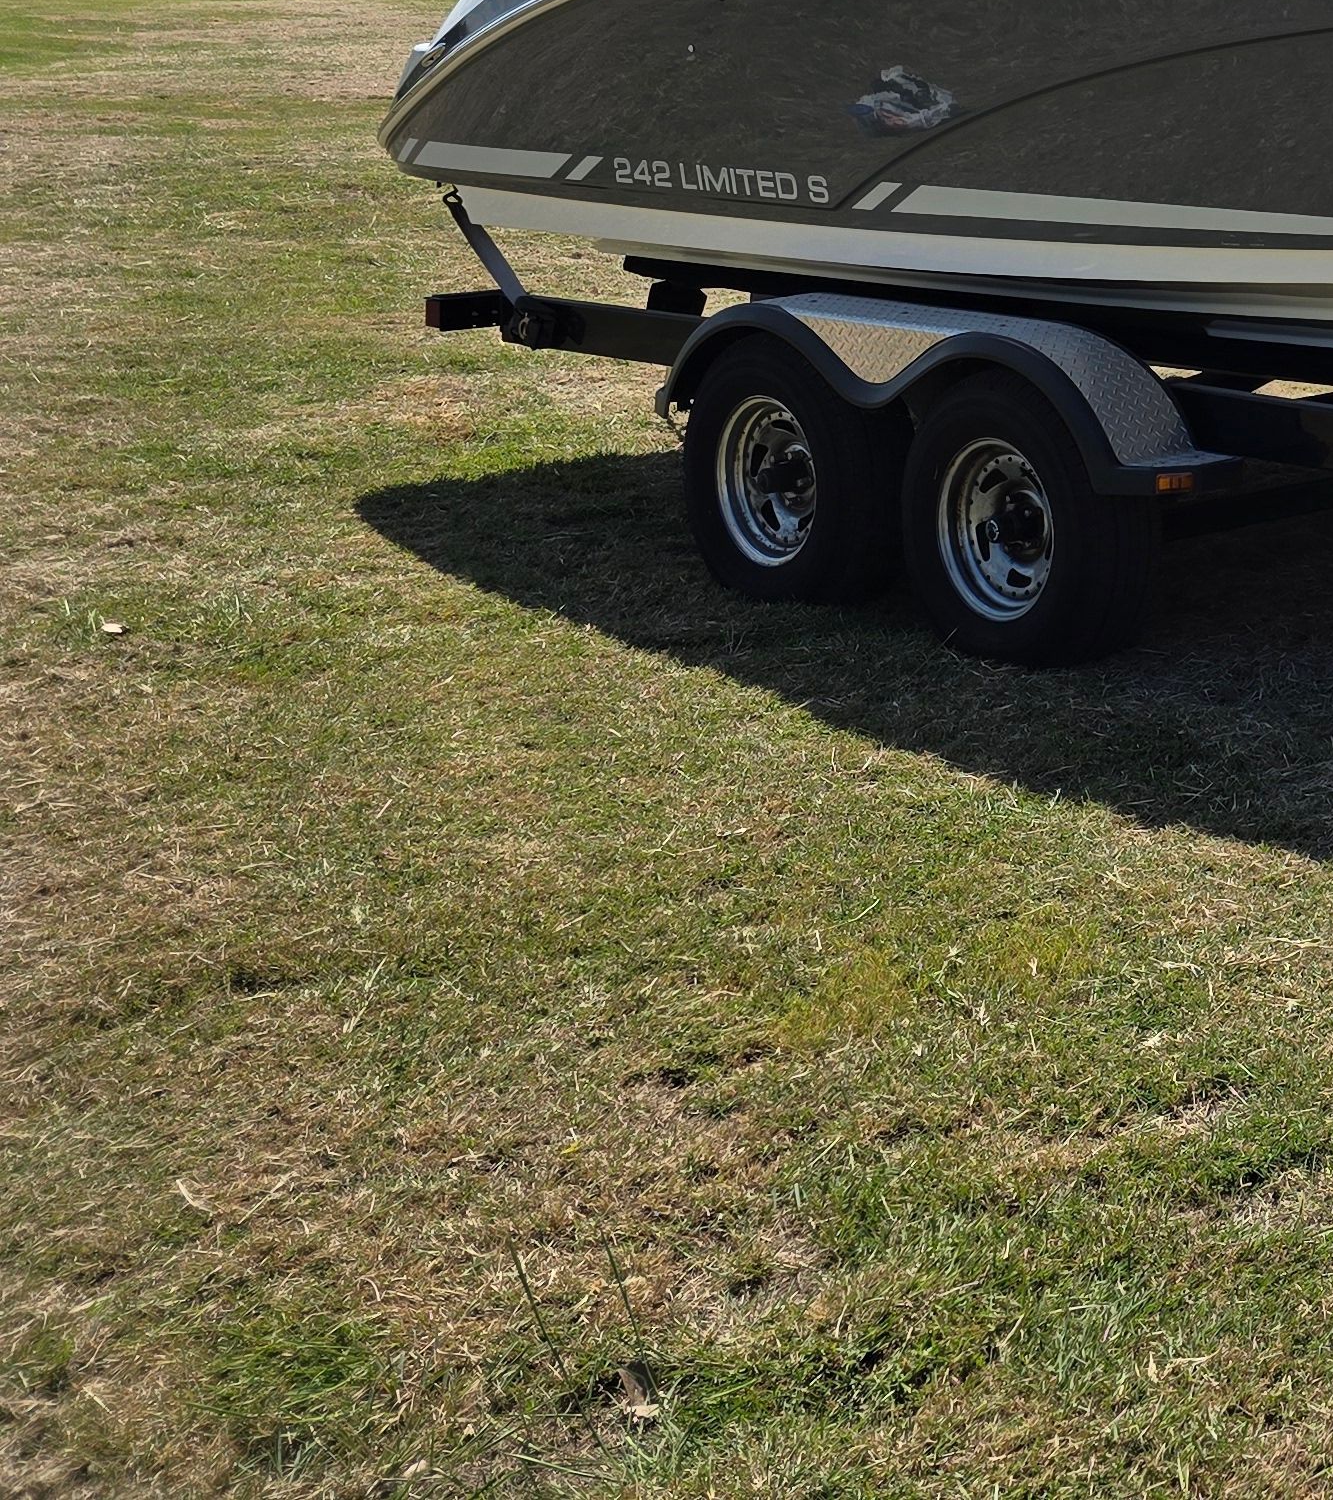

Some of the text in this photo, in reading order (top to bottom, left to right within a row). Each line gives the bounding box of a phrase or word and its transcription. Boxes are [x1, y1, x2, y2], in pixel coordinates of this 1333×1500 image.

[613, 157, 830, 204] 242 LIMITED S
